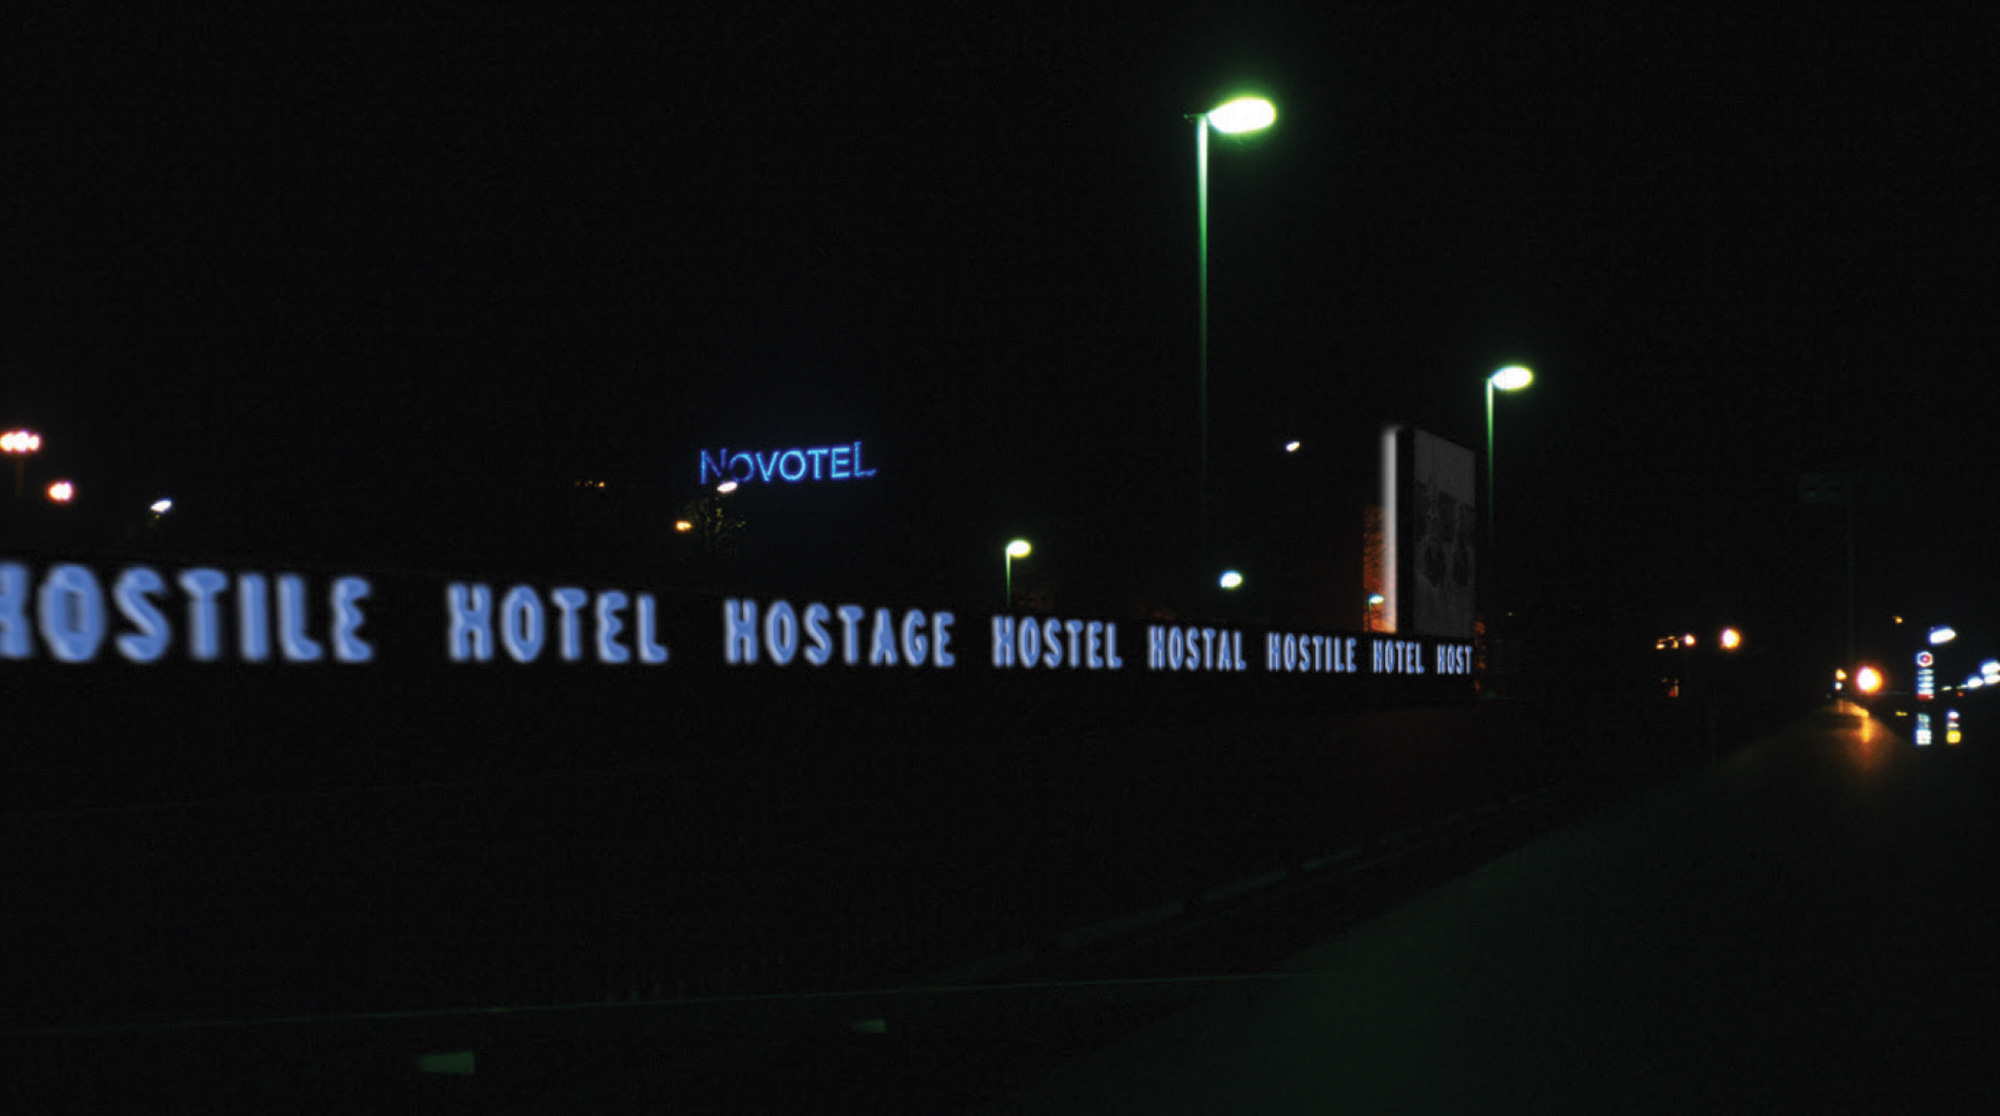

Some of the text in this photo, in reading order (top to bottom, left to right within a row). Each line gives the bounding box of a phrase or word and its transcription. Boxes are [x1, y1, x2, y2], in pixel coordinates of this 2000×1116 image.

[700, 440, 876, 485] NOVOTEL
[447, 583, 669, 664] HOTEL
[724, 599, 955, 667] HOSTAGE
[992, 615, 1123, 669] HOSTEL
[1148, 625, 1247, 671] HOSTAL
[1267, 632, 1357, 673] HOSTILE
[1372, 639, 1425, 674] HOTEL
[1436, 644, 1472, 675] HOST
